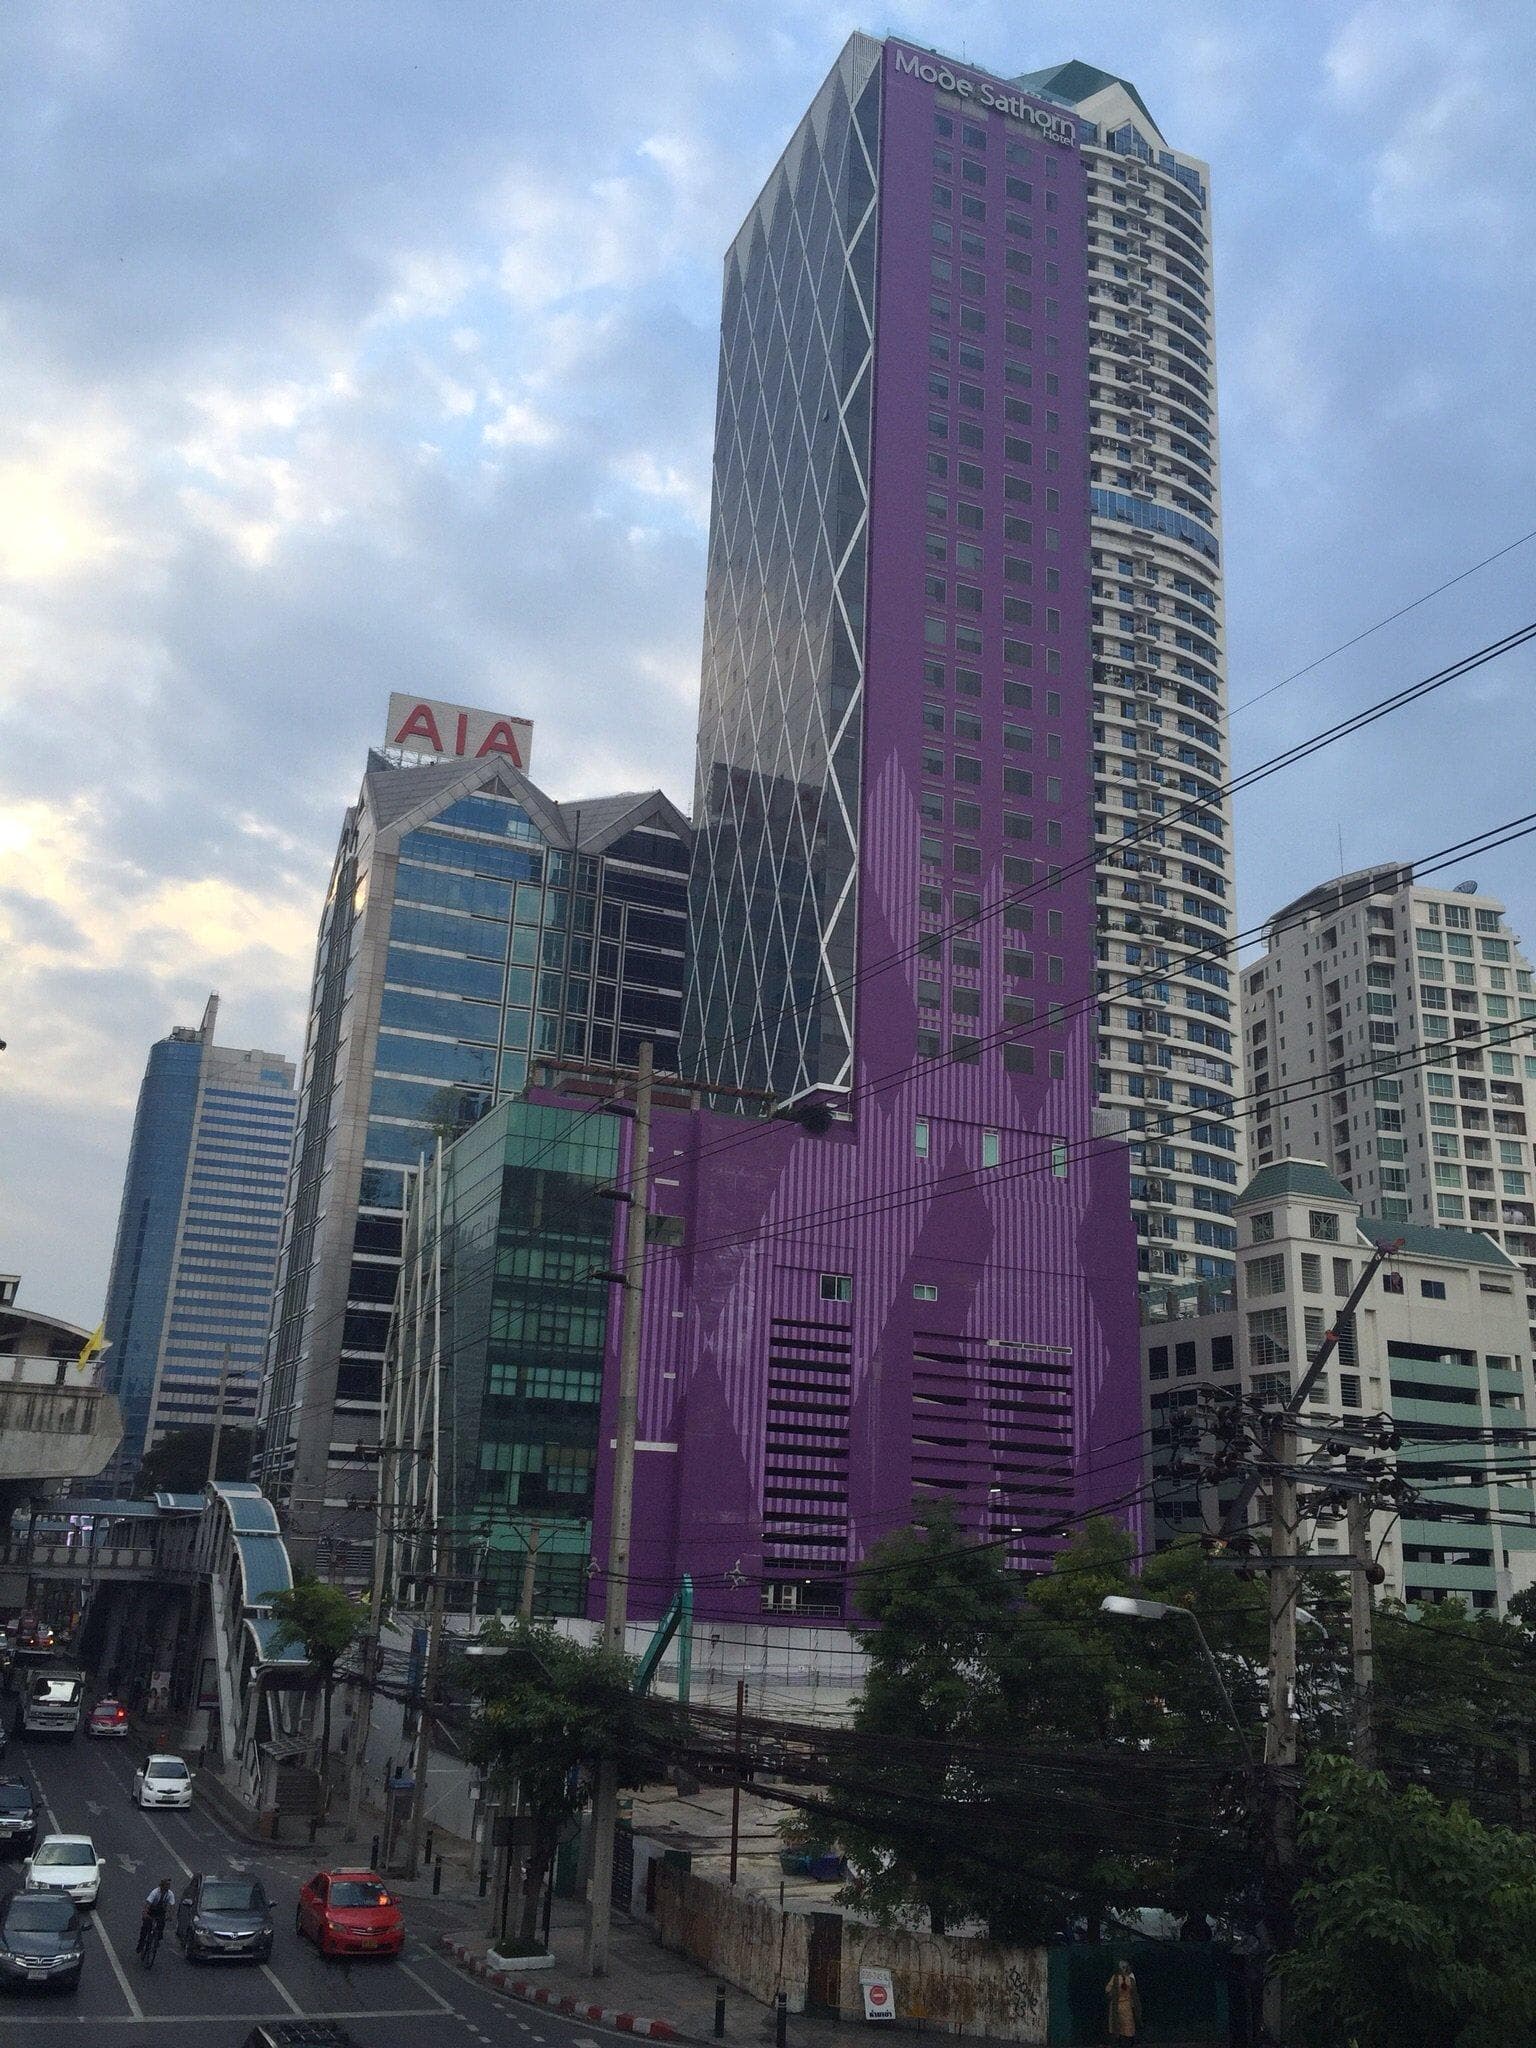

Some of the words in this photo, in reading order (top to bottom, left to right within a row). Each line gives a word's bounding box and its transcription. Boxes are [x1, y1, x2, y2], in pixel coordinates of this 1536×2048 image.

[895, 50, 973, 97] Mode
[979, 83, 1076, 139] Sathorn
[1043, 126, 1075, 148] Hotel
[394, 704, 523, 768] AIA
